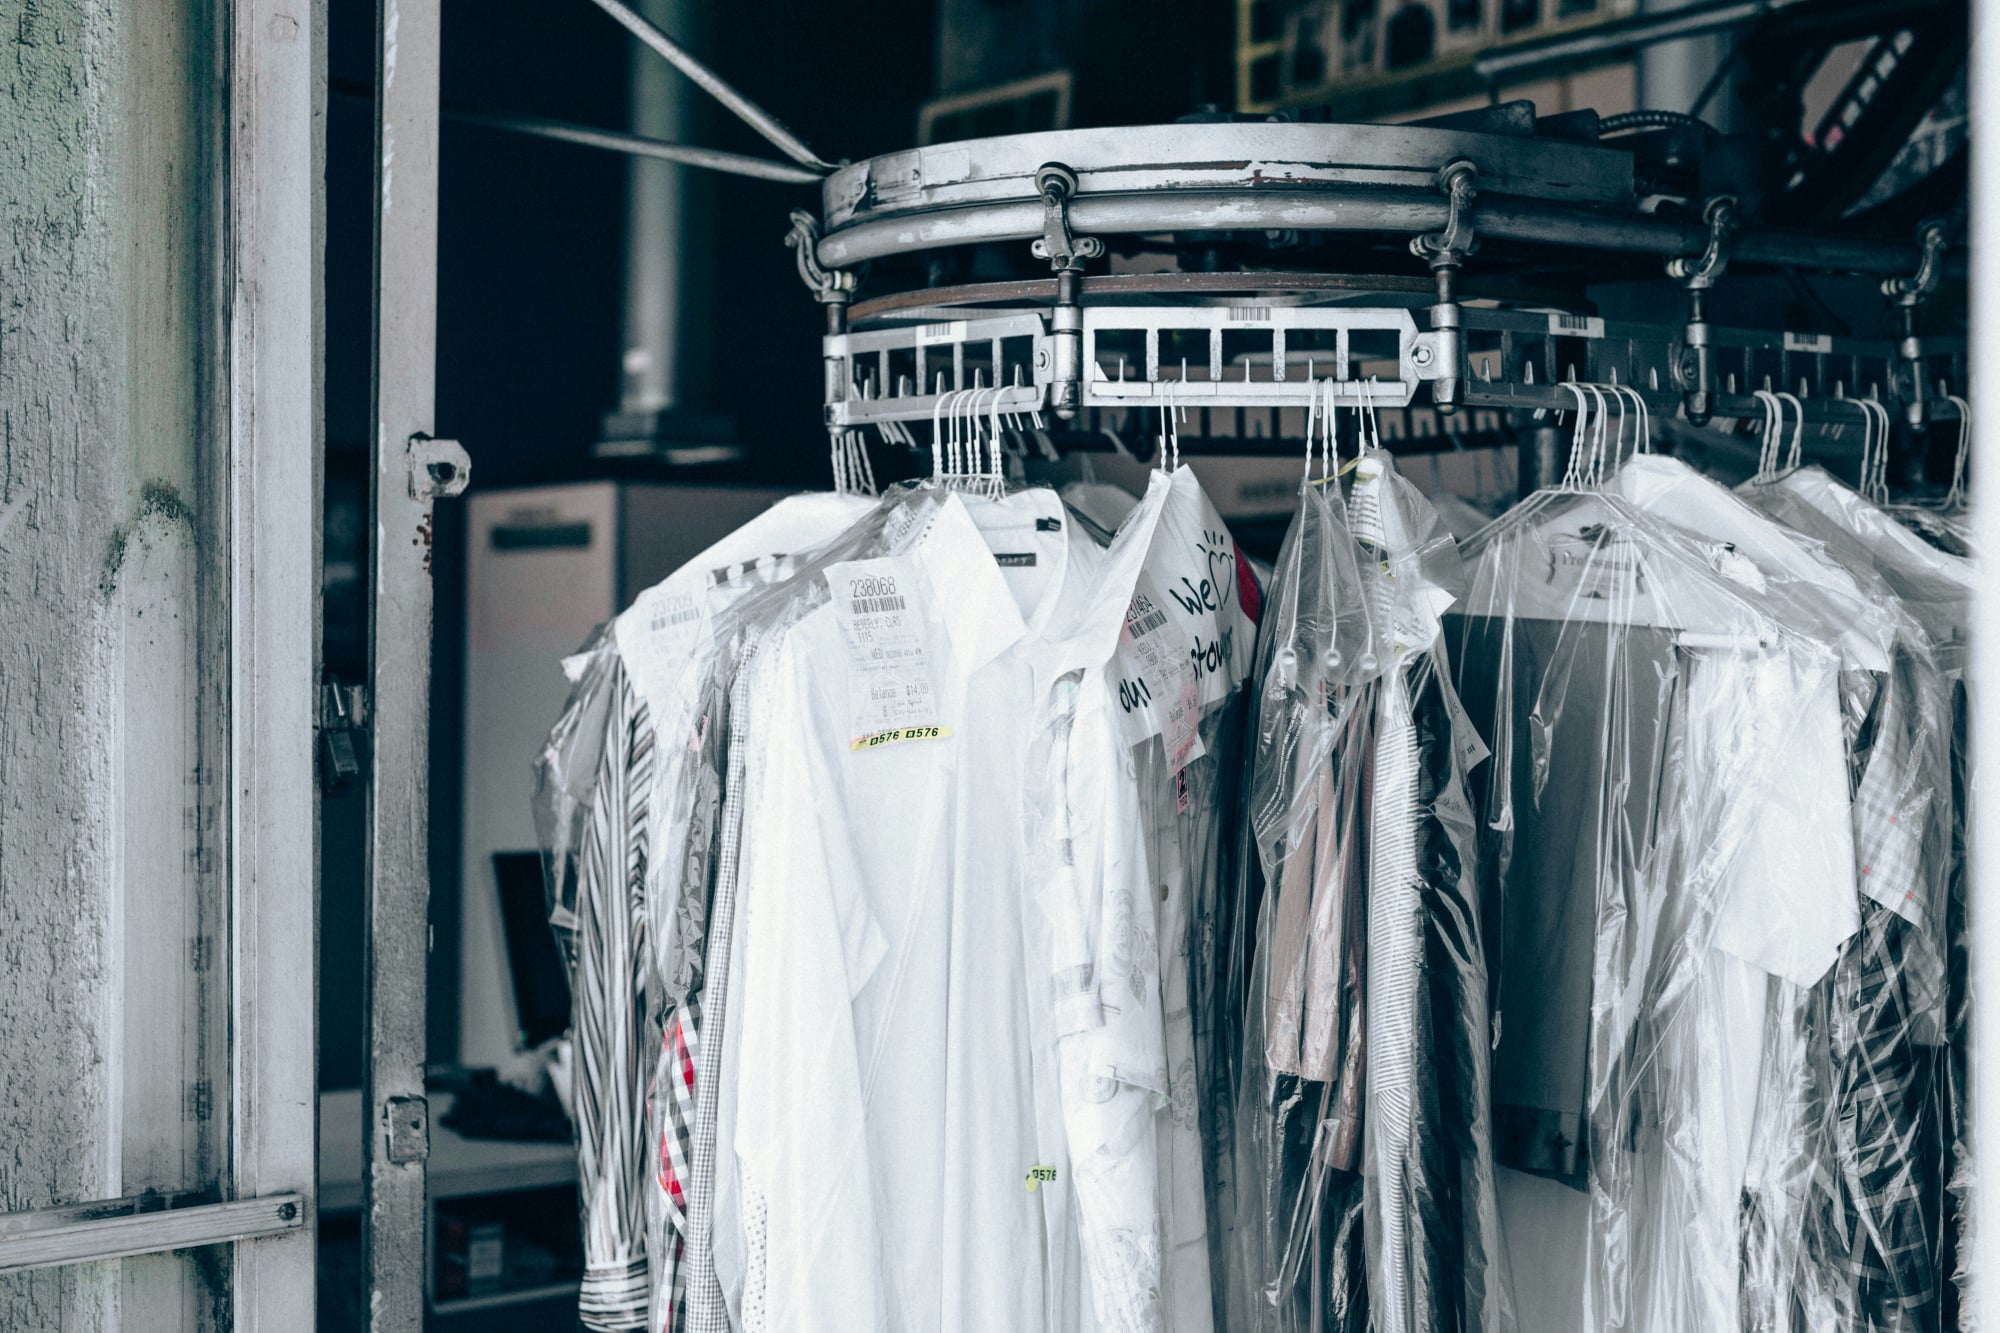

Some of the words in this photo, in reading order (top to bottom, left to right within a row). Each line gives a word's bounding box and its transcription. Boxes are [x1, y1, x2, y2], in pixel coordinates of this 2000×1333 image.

[850, 576, 896, 598] 238068
[1169, 577, 1217, 616] We
[871, 687, 897, 701] Balance
[906, 682, 929, 696] $14.00
